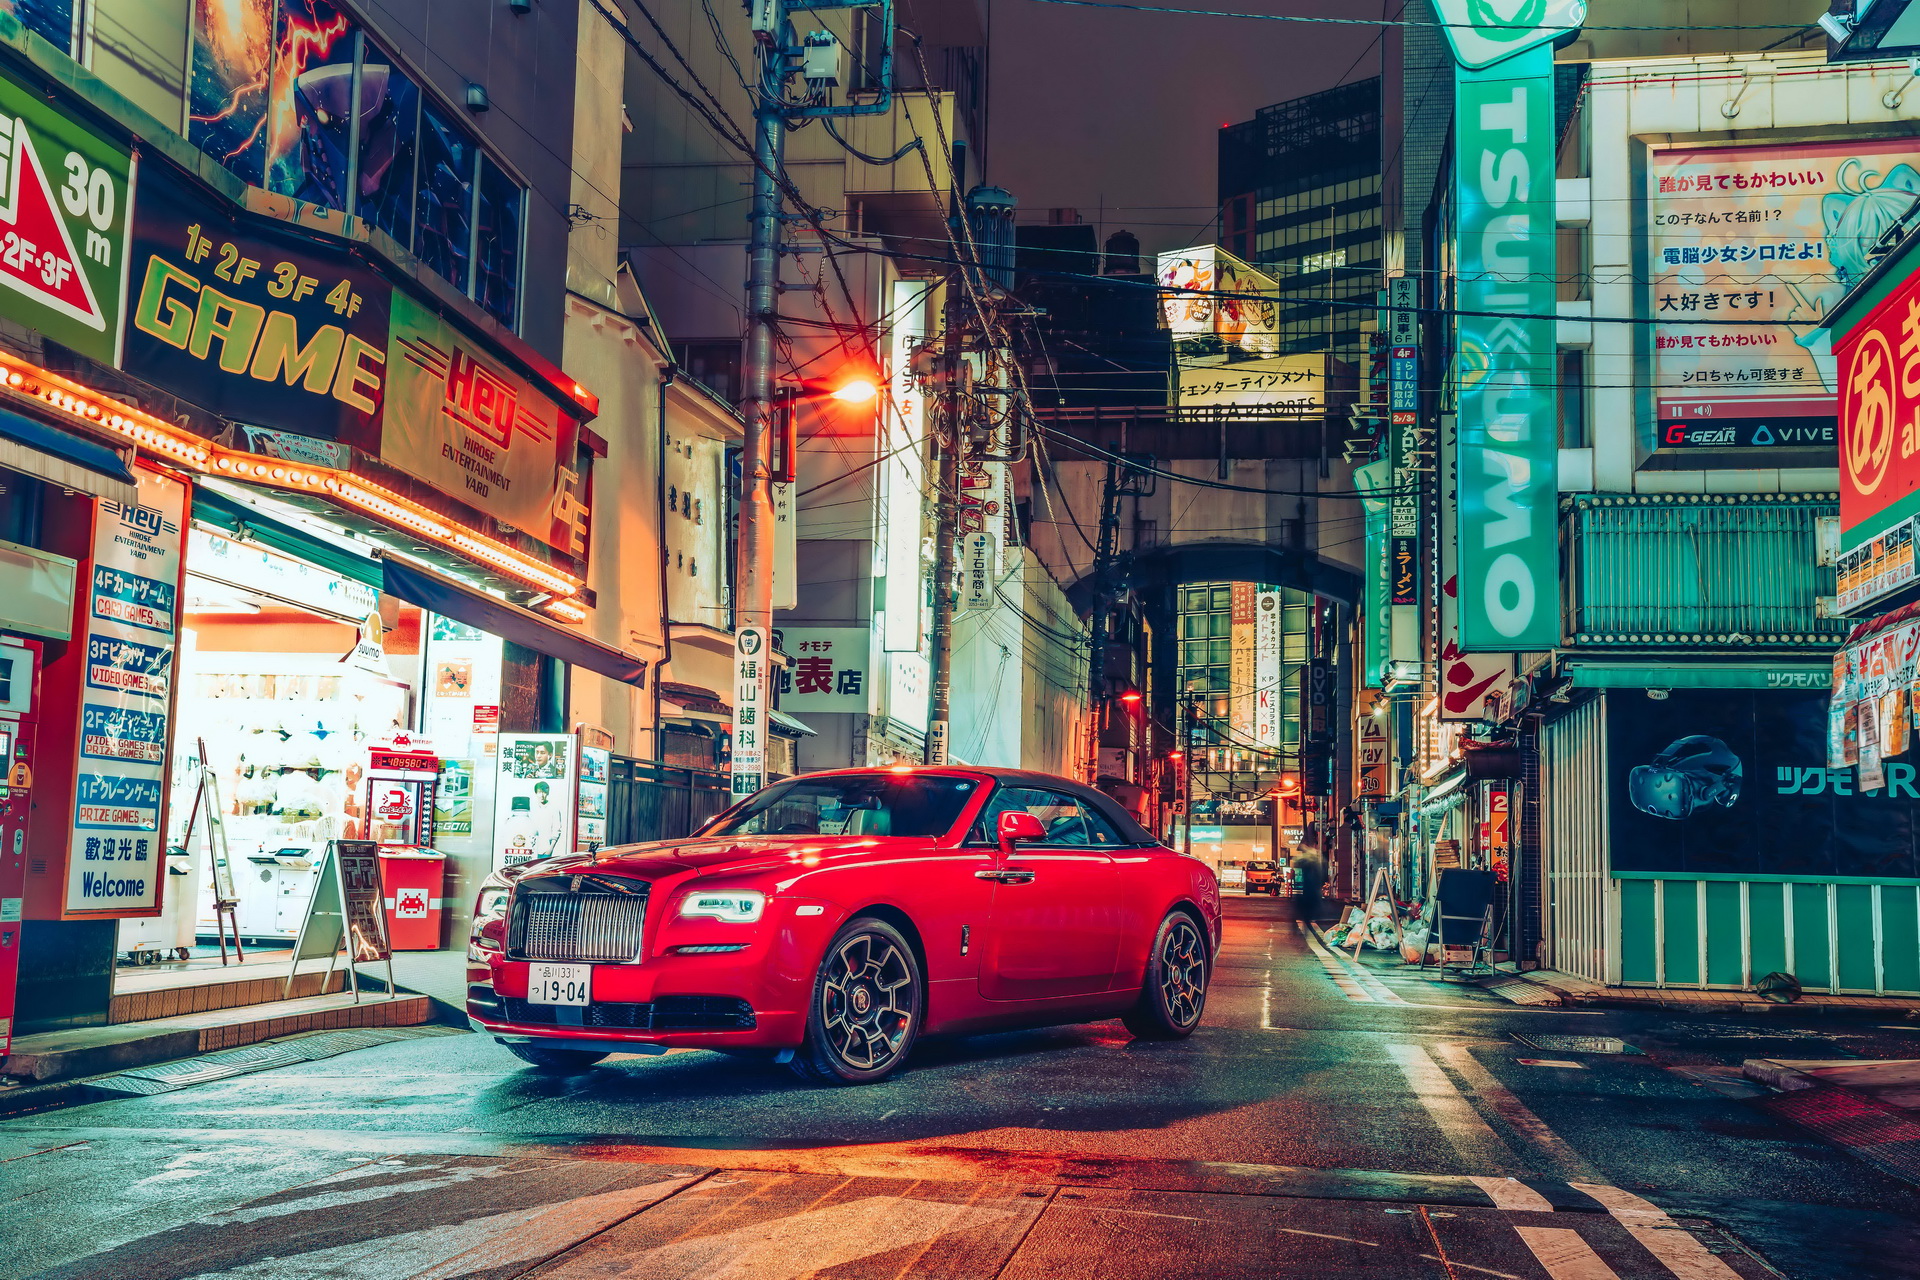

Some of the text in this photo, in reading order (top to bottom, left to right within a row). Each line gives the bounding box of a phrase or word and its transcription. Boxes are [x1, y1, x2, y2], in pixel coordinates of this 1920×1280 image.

[62, 151, 114, 232] 30
[1659, 171, 1824, 194] 誰が見てもかわいい
[1655, 209, 1782, 226] この子なんて名前！？
[86, 228, 111, 267] m
[1663, 243, 1822, 265] 電脳少女シロだよ！
[186, 223, 363, 319] 1F 2F 3F 4F
[1659, 291, 1774, 311] 大好きです！
[134, 254, 386, 416] GAME
[1395, 335, 1413, 343] 6F
[1397, 348, 1411, 358] 4F
[1480, 87, 1536, 638] TSUKUMO
[1404, 361, 1414, 408] らしんばん
[1682, 367, 1804, 382] シロちゃん可愛すぎ
[445, 345, 517, 447] Hey
[1852, 347, 1890, 475] あ
[1666, 424, 1736, 443] G-GEAR
[1779, 427, 1834, 441] VIVE
[463, 436, 495, 465] HIROSE
[442, 443, 511, 492] ENTERTAINMENT
[465, 475, 489, 498] YARD
[120, 503, 163, 536] Hey
[114, 535, 165, 556] ENTERTAINMENT
[129, 530, 152, 543] HIROSE
[130, 549, 147, 560] YARD
[972, 548, 985, 590] 千石電商
[1396, 552, 1412, 596] ラーメン
[95, 570, 165, 605] 4Fカードゲーム
[97, 598, 122, 618] CARD
[124, 604, 154, 625] GAMES
[799, 641, 833, 651] オモテ
[91, 667, 120, 684] VIDEO
[122, 673, 149, 690] GAMES
[1313, 667, 1325, 704] DVD
[739, 661, 756, 748] 福山歯科
[85, 710, 104, 728] 2F
[86, 735, 117, 748] VIDE
[118, 740, 144, 751] GAMES
[117, 749, 144, 759] GAMES
[932, 740, 944, 765] 千石
[80, 807, 139, 824] PRIZE GAMES
[85, 837, 148, 861] 歡迎光臨
[83, 871, 144, 897] Welcome
[543, 980, 585, 1002] 19-04
